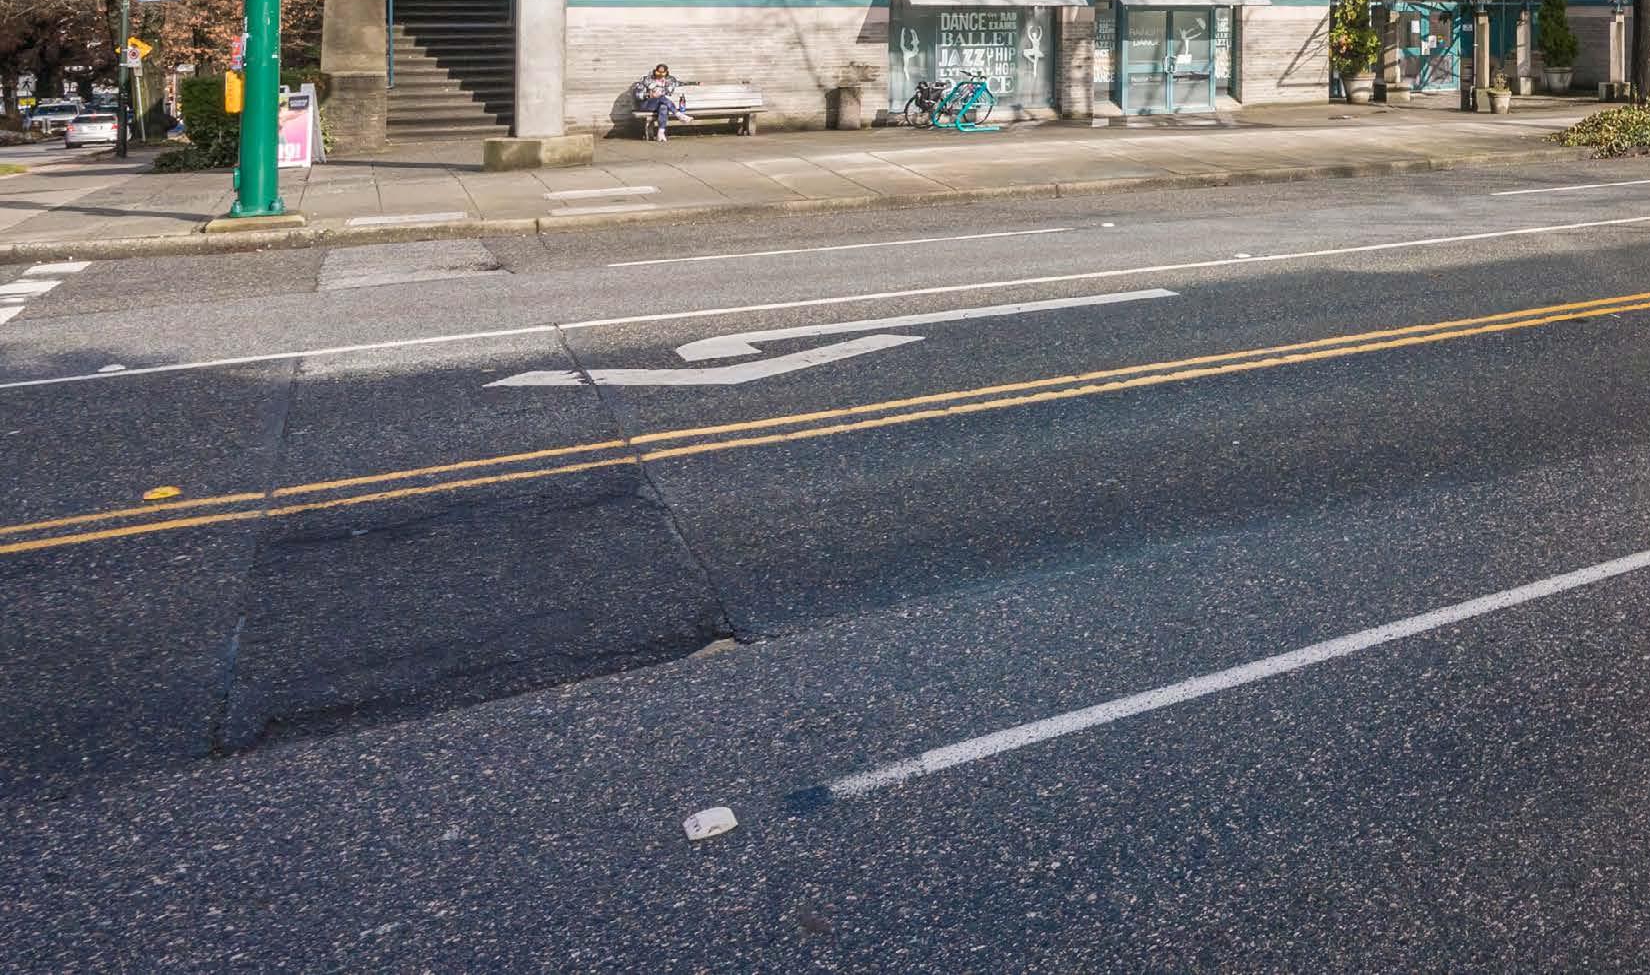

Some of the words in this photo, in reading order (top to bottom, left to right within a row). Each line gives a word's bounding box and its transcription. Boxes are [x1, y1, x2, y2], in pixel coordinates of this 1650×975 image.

[941, 12, 986, 30] DANCE
[941, 32, 1017, 46] BALLET
[939, 48, 986, 67] JAZZ
[995, 47, 1016, 62] HIP
